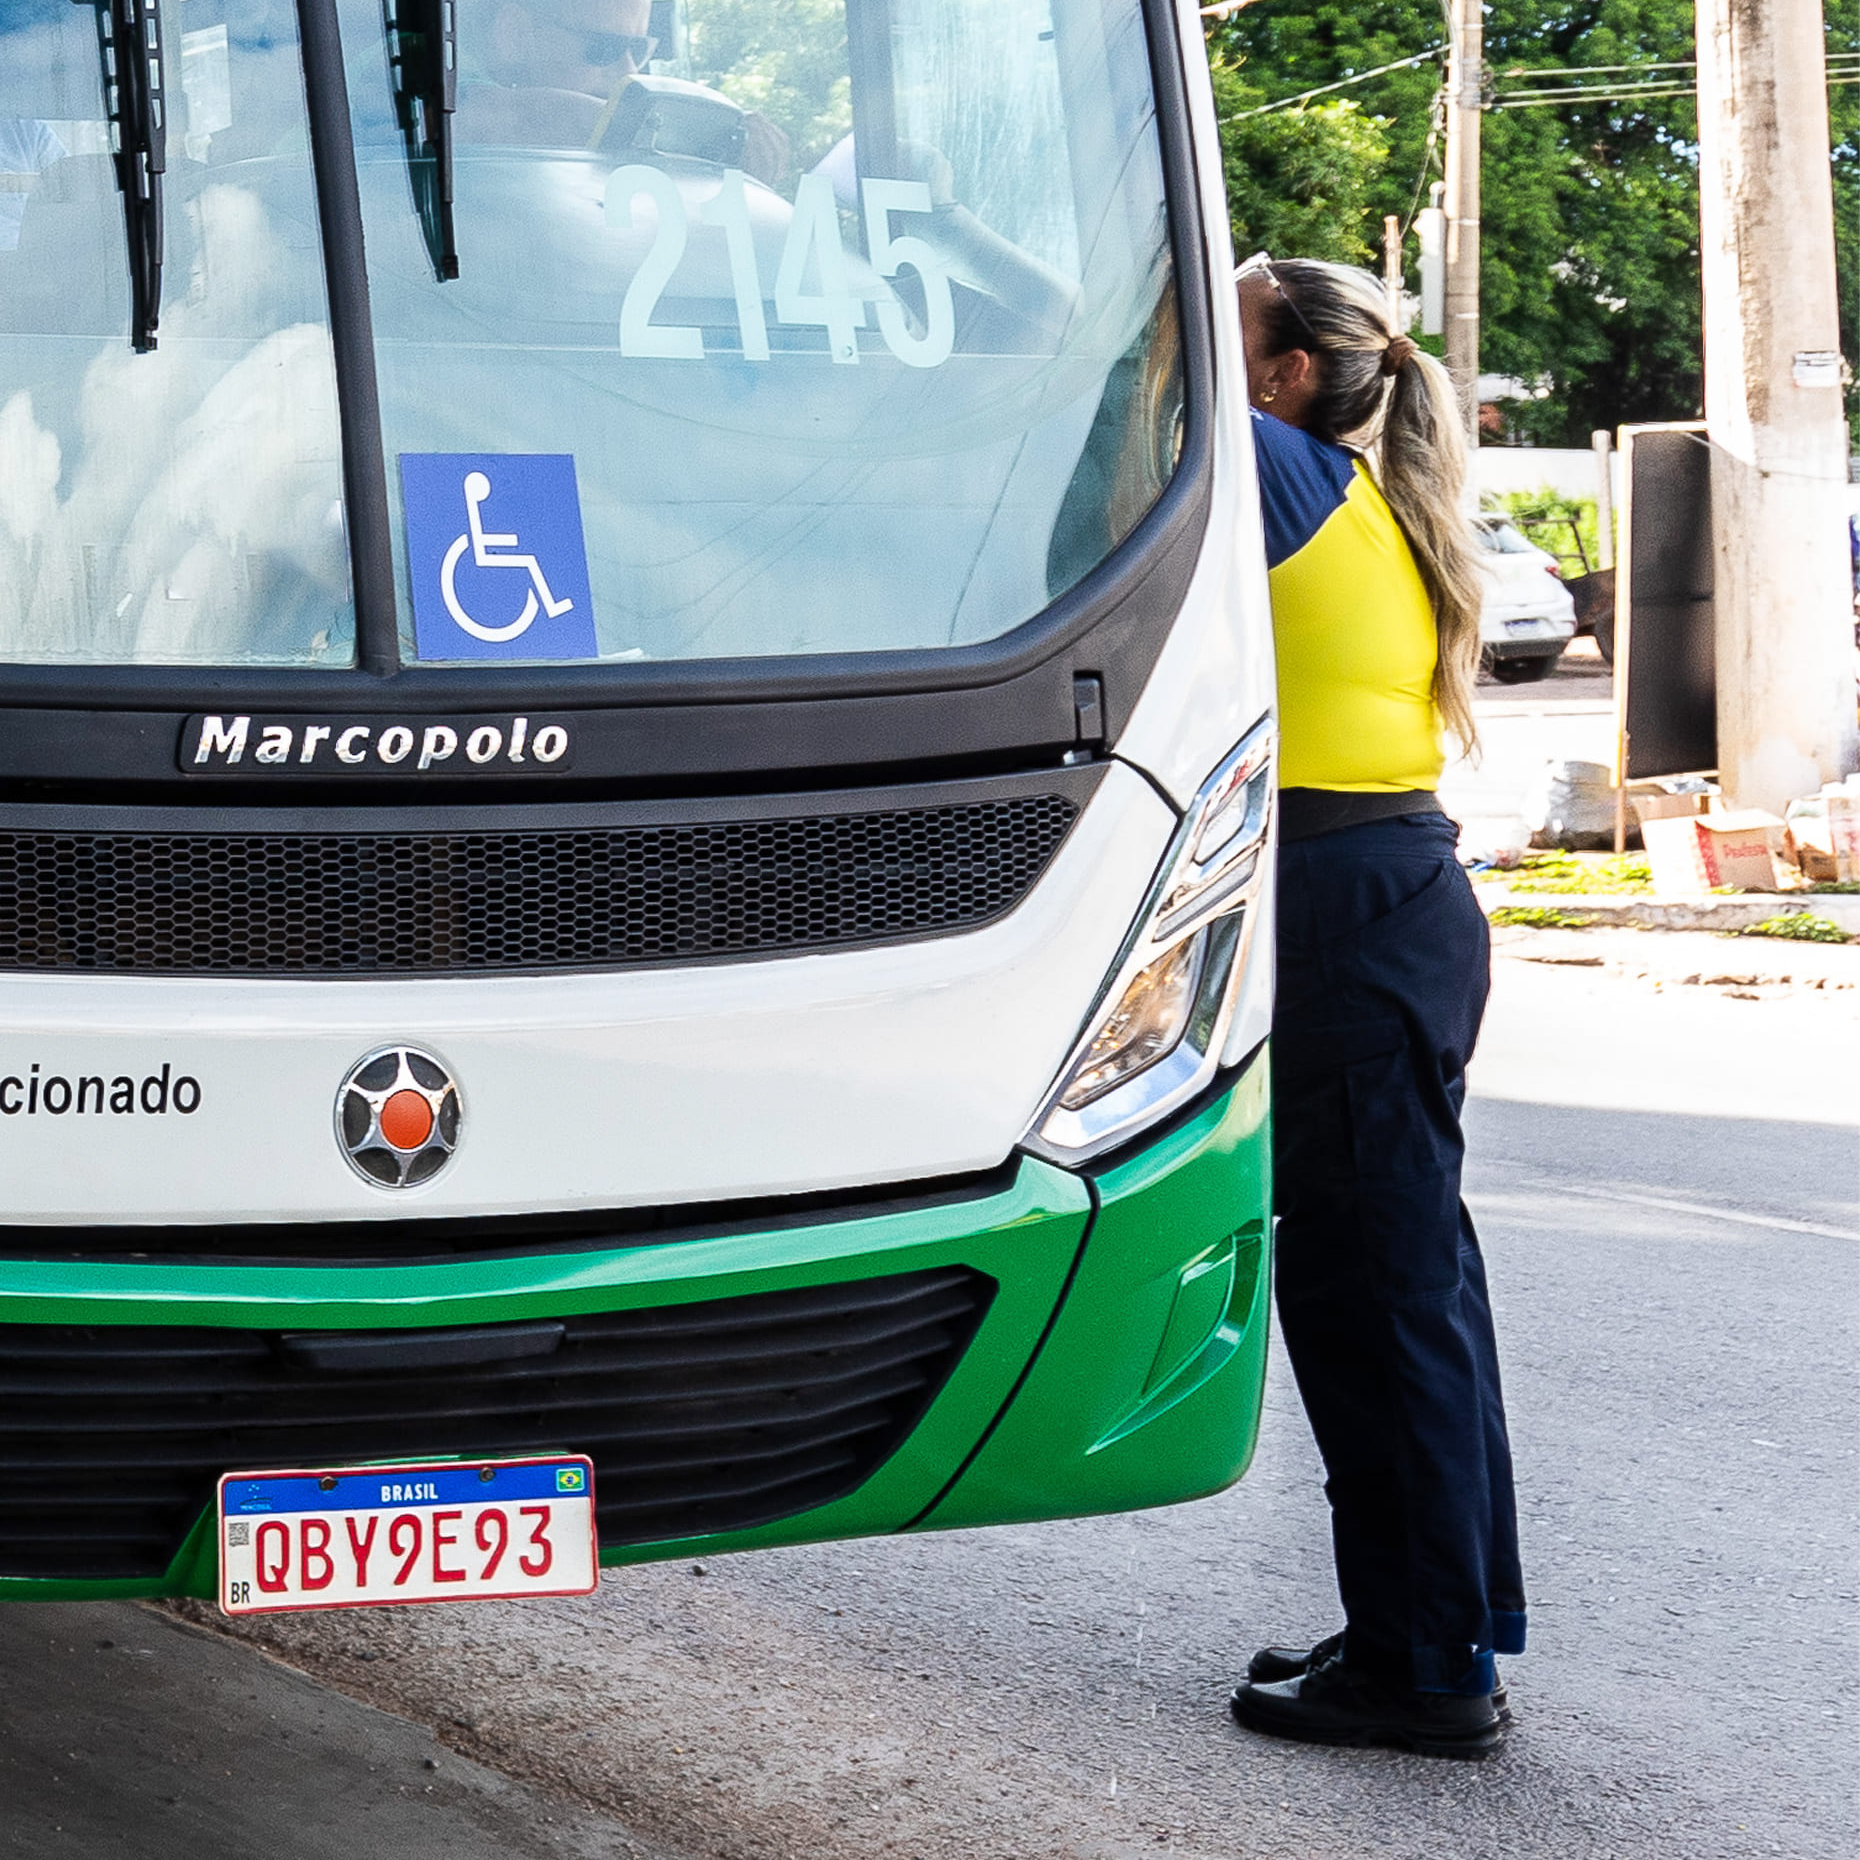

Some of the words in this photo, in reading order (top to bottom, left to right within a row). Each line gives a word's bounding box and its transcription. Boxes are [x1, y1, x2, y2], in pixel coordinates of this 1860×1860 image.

[604, 163, 956, 369] 2145
[194, 715, 569, 770] Marcopolo
[380, 1482, 439, 1503] BRASIL
[255, 1505, 553, 1593] QBY9E93
[231, 1581, 250, 1604] BR
